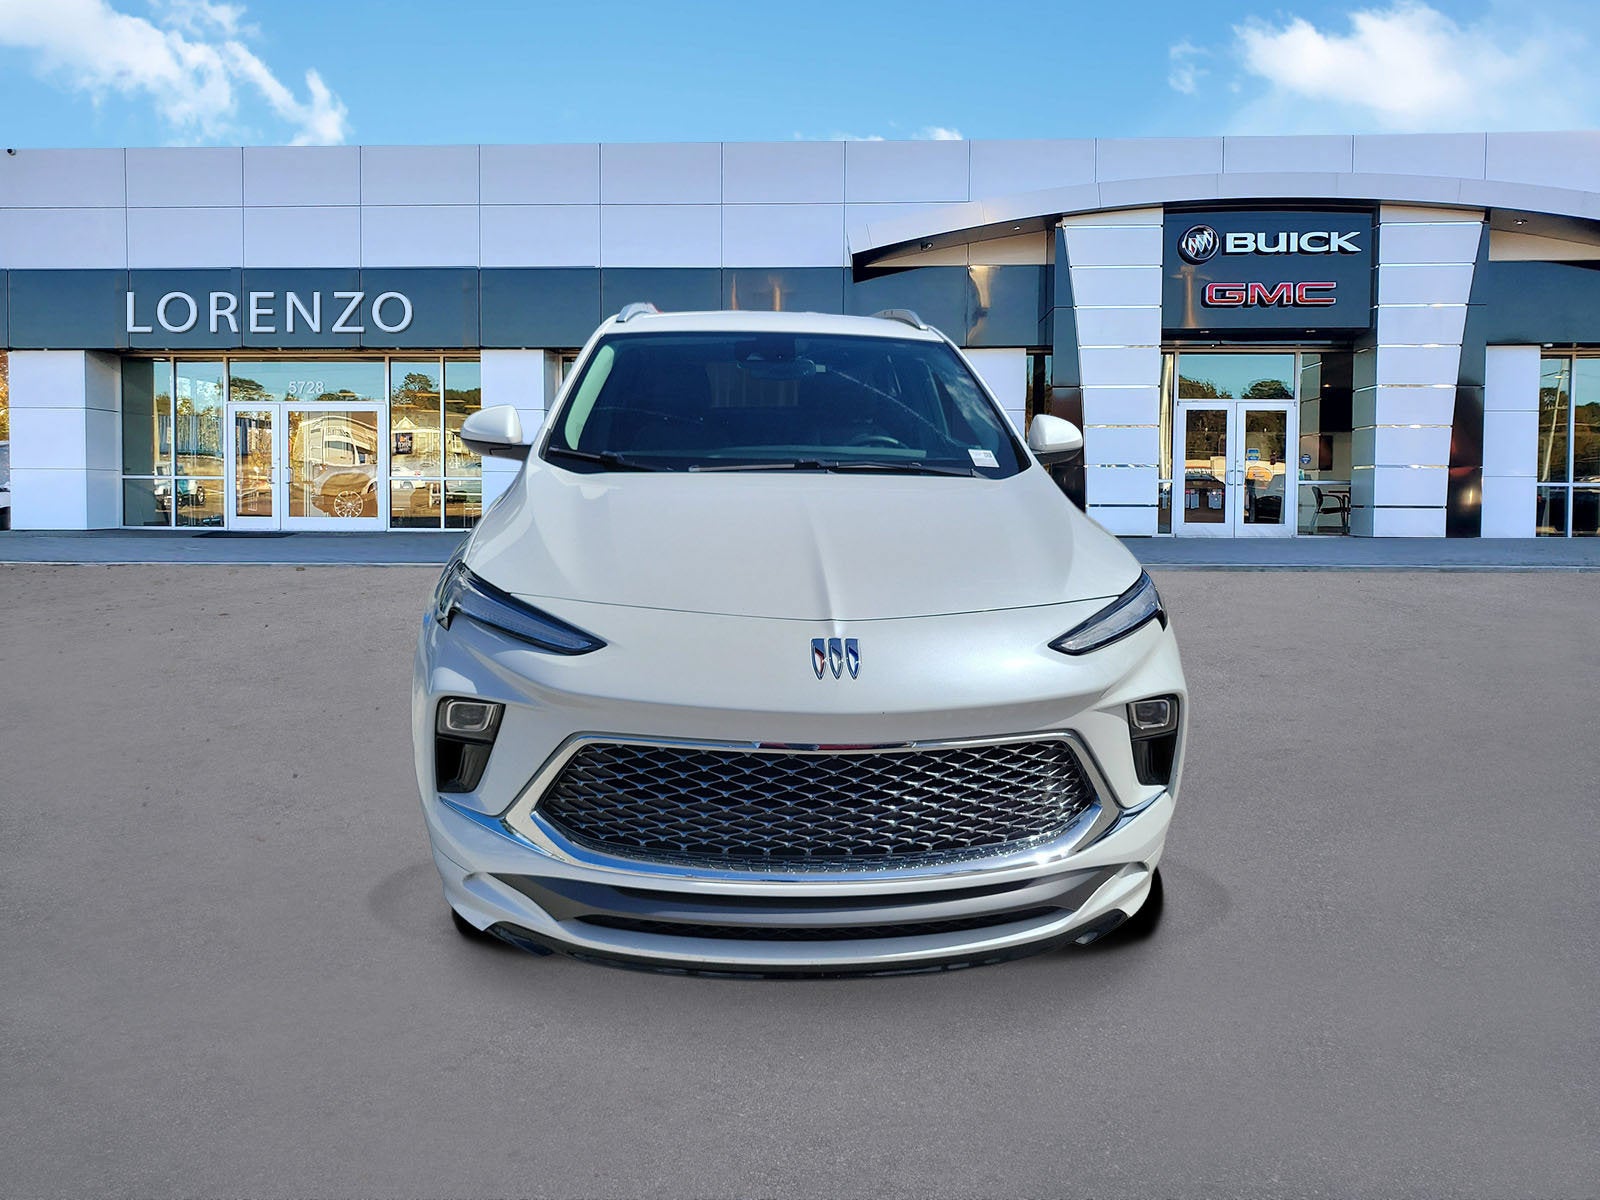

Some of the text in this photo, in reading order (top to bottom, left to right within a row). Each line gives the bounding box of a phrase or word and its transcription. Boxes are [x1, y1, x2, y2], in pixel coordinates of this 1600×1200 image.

[1225, 231, 1362, 253] BUICK
[1205, 282, 1337, 305] GMC
[125, 291, 414, 333] LORENZO
[288, 380, 325, 394] 5728
